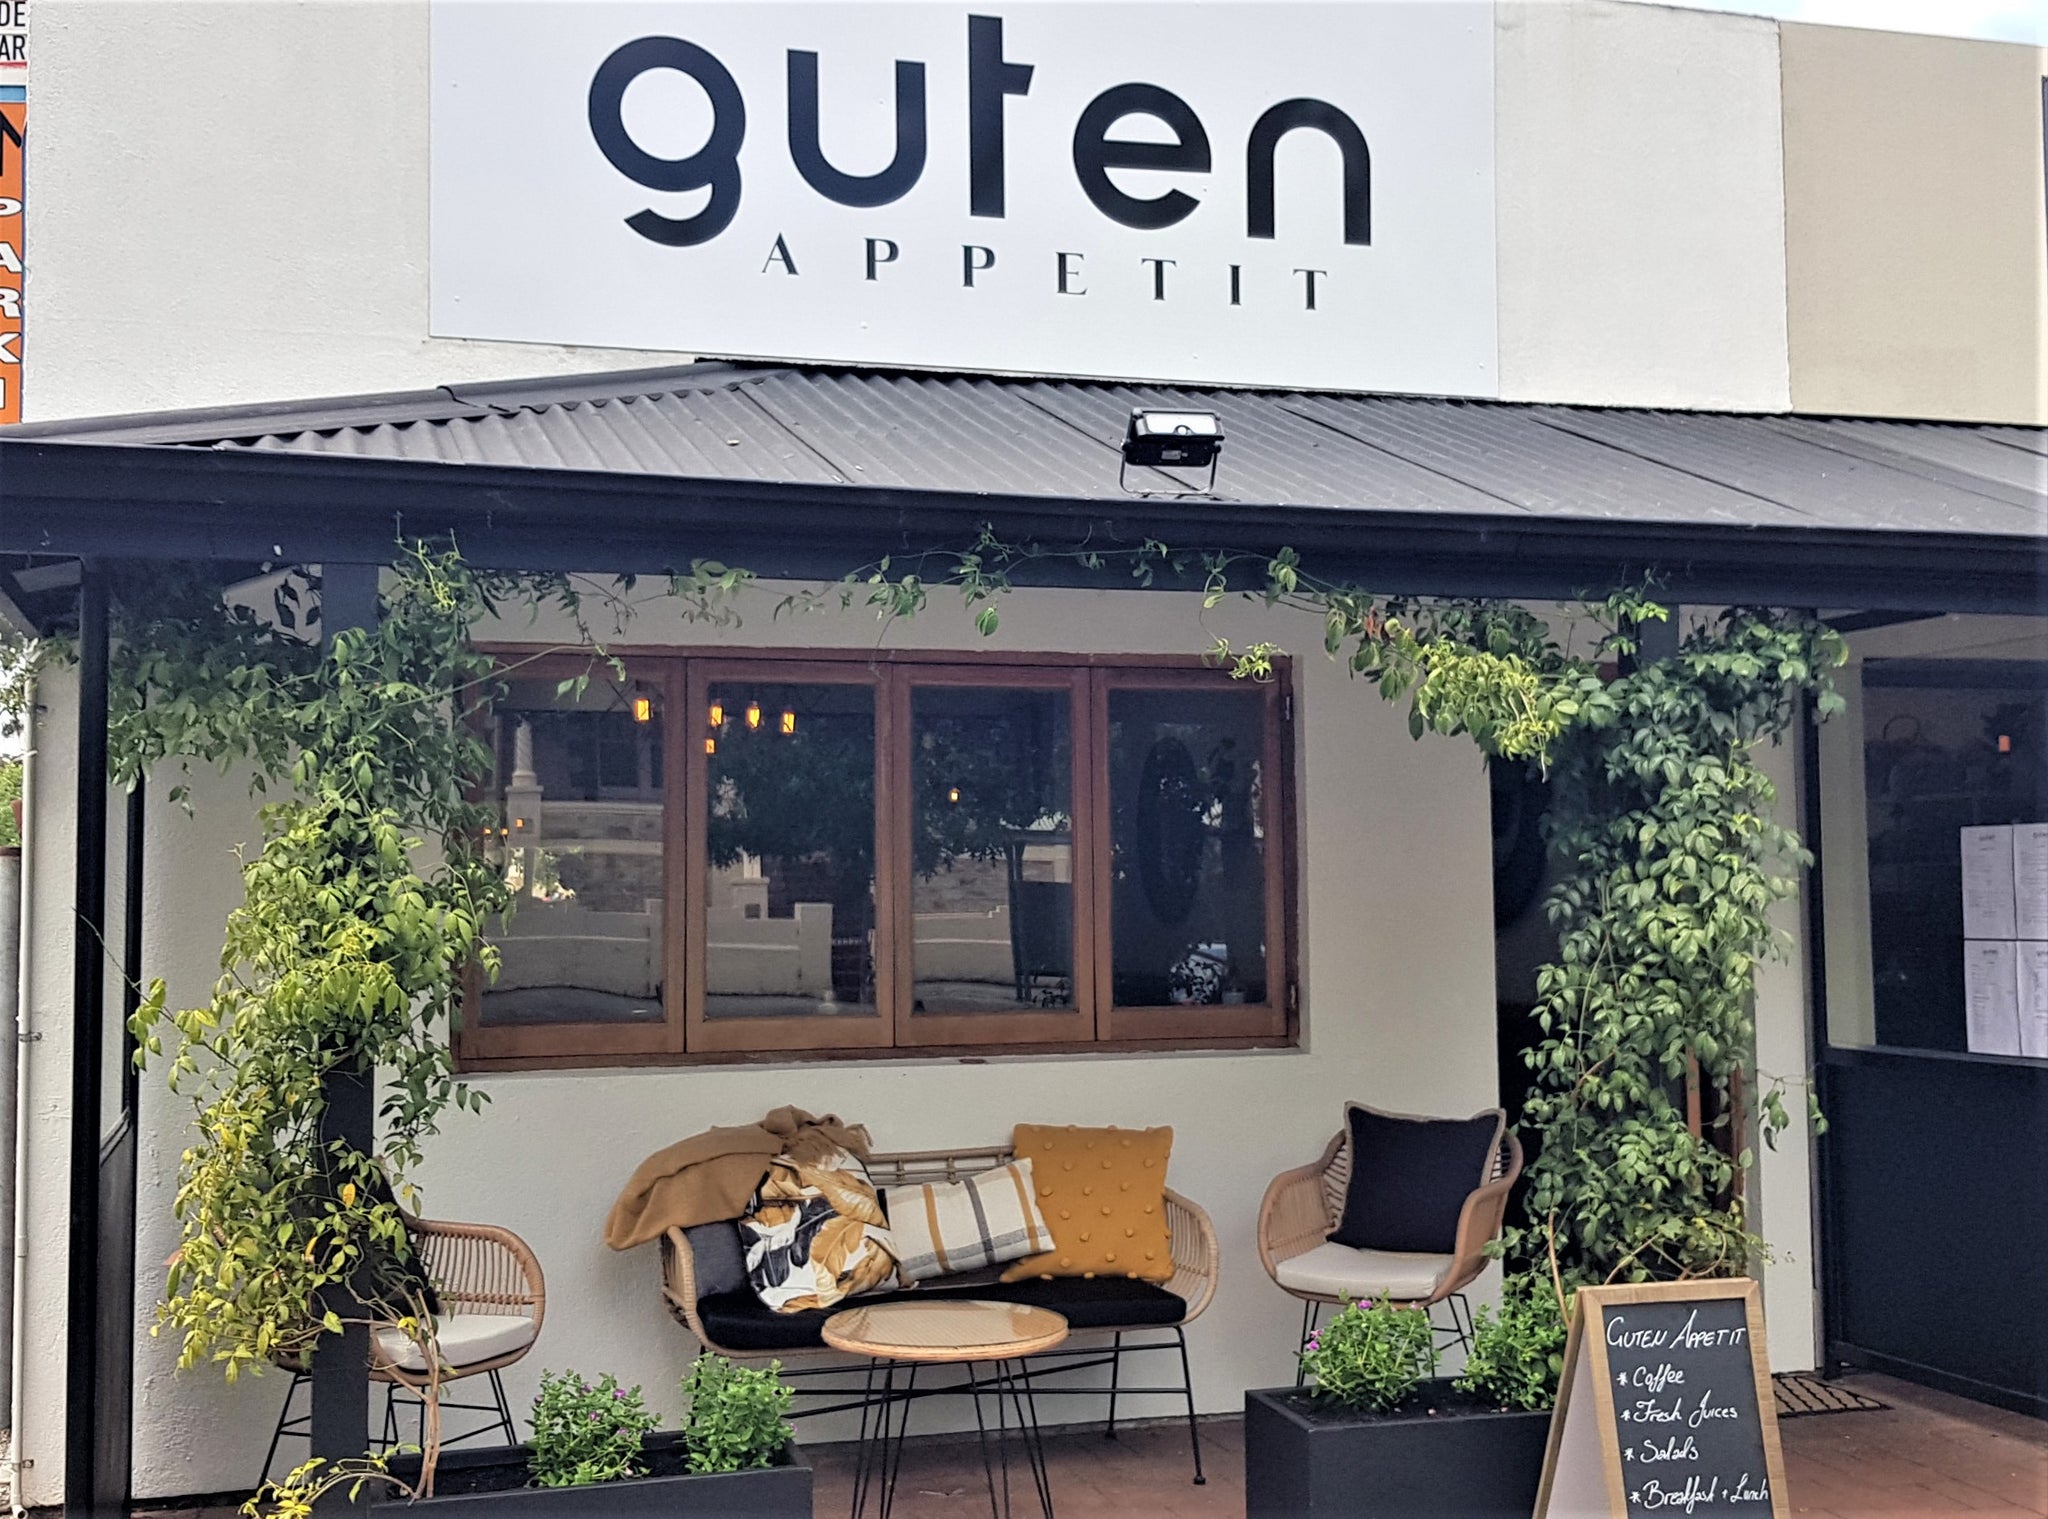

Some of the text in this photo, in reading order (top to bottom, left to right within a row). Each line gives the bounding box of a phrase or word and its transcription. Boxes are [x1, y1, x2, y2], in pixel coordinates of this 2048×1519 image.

[588, 13, 1371, 247] guten
[761, 232, 1328, 311] APPETIT
[1632, 1363, 1685, 1392] Coffee
[1633, 1389, 1738, 1428] Fresh Juices
[1639, 1436, 1699, 1463] Salads
[1642, 1475, 1718, 1514] Breakfast
[1730, 1472, 1769, 1503] Lunch
